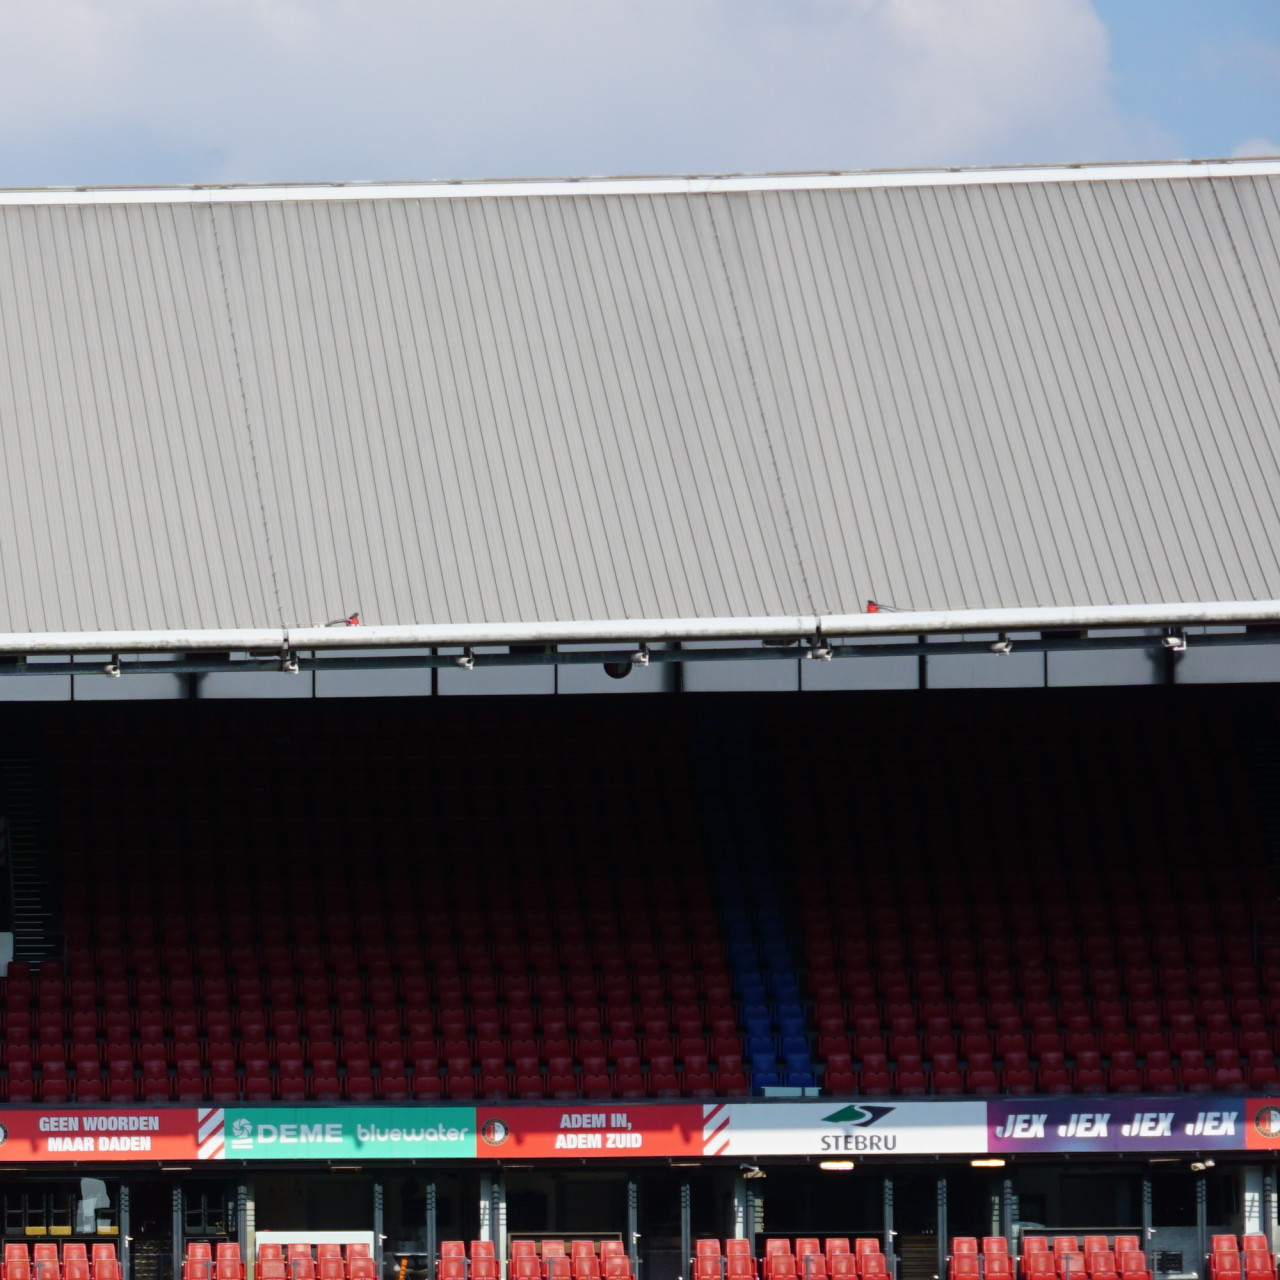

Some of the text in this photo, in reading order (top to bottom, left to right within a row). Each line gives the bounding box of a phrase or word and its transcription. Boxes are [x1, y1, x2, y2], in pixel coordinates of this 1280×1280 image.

[39, 1116, 160, 1132] GEEN WOORDEN
[560, 1112, 633, 1131] ADEM IN,
[996, 1114, 1048, 1139] JEX
[1058, 1113, 1111, 1138] JEX
[1122, 1112, 1175, 1137] JEX
[1185, 1111, 1238, 1137] JEX
[258, 1123, 344, 1143] DEME
[357, 1123, 469, 1143] bluewater
[555, 1132, 642, 1149] ADEM ZUID
[48, 1137, 151, 1152] MAAR DADEN
[821, 1135, 897, 1151] STEBRU
